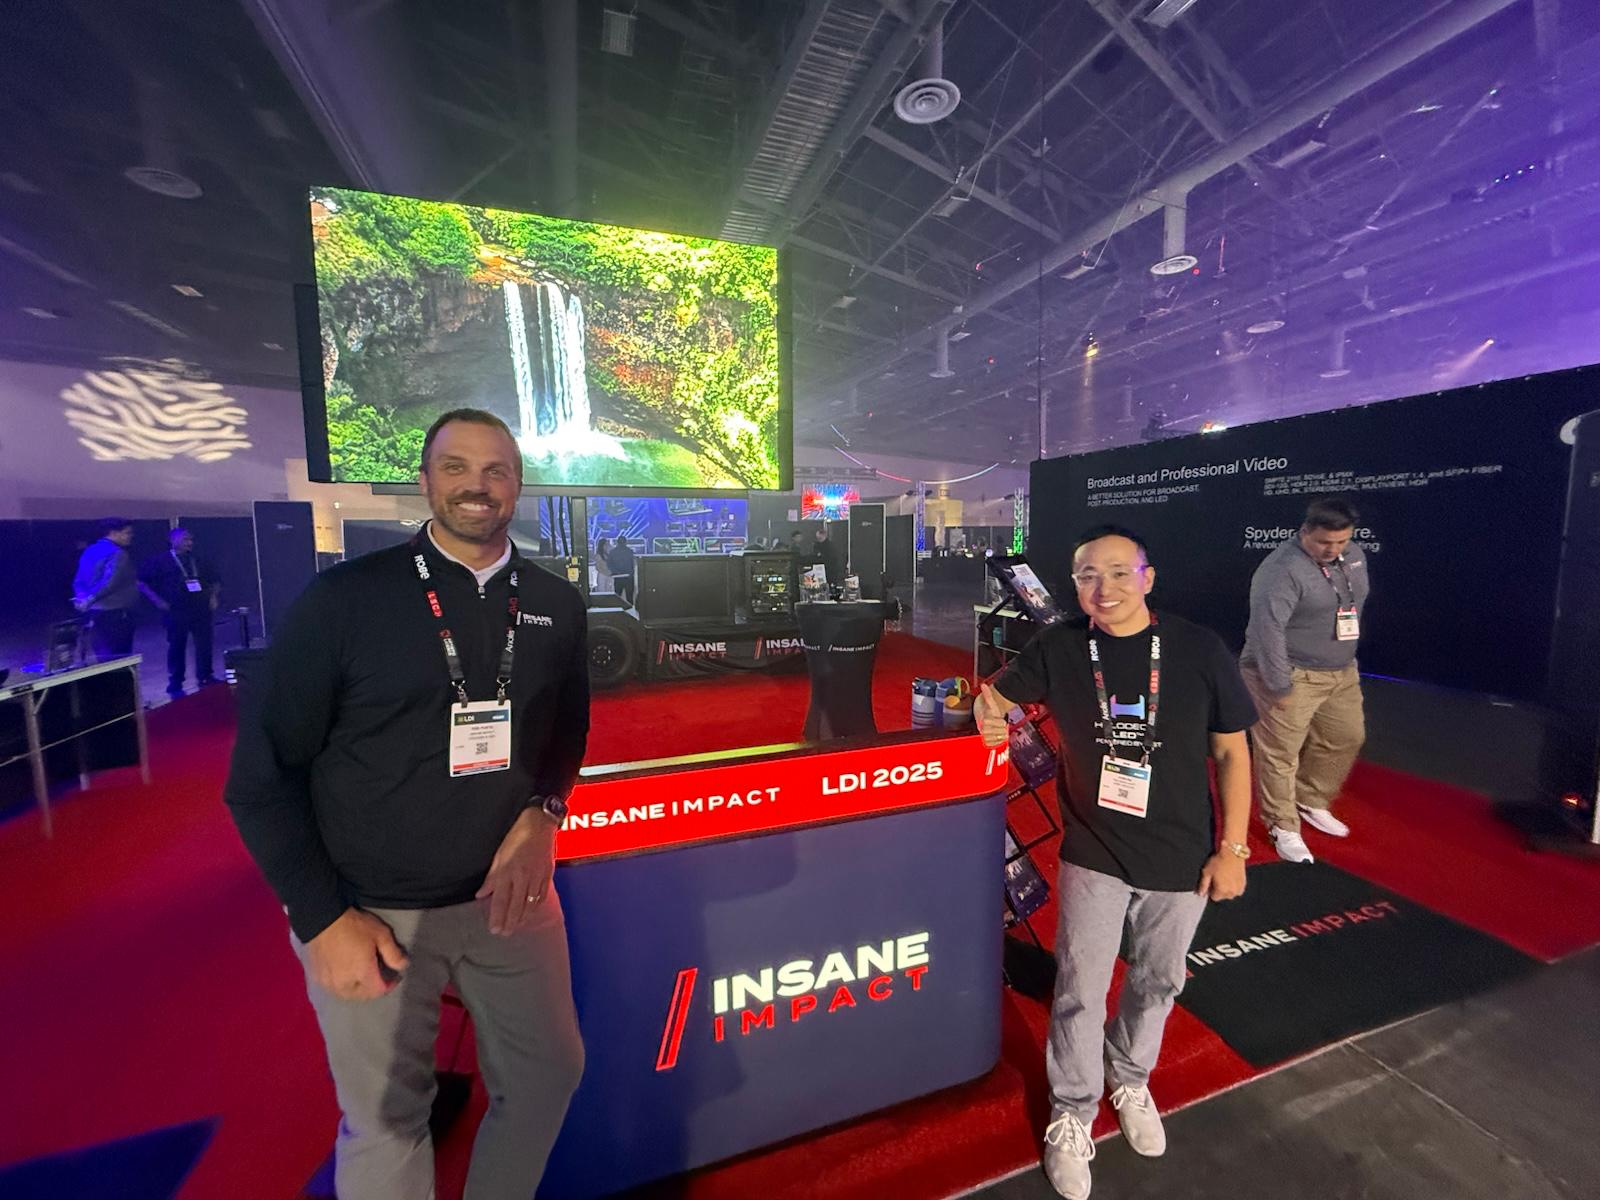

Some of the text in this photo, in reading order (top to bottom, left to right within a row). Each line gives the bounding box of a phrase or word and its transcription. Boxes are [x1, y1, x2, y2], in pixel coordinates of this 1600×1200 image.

[1087, 456, 1288, 489] Broadcast and Professional Video
[1143, 488, 1156, 496] FOR
[1155, 495, 1168, 503] LED
[668, 642, 727, 653] INSANE
[822, 761, 943, 795] LDI 2025
[672, 787, 781, 816] IMPACT
[1187, 901, 1399, 966] INSANE IMPACT
[713, 932, 930, 1014] INSANE
[713, 966, 930, 1042] IMPACT
